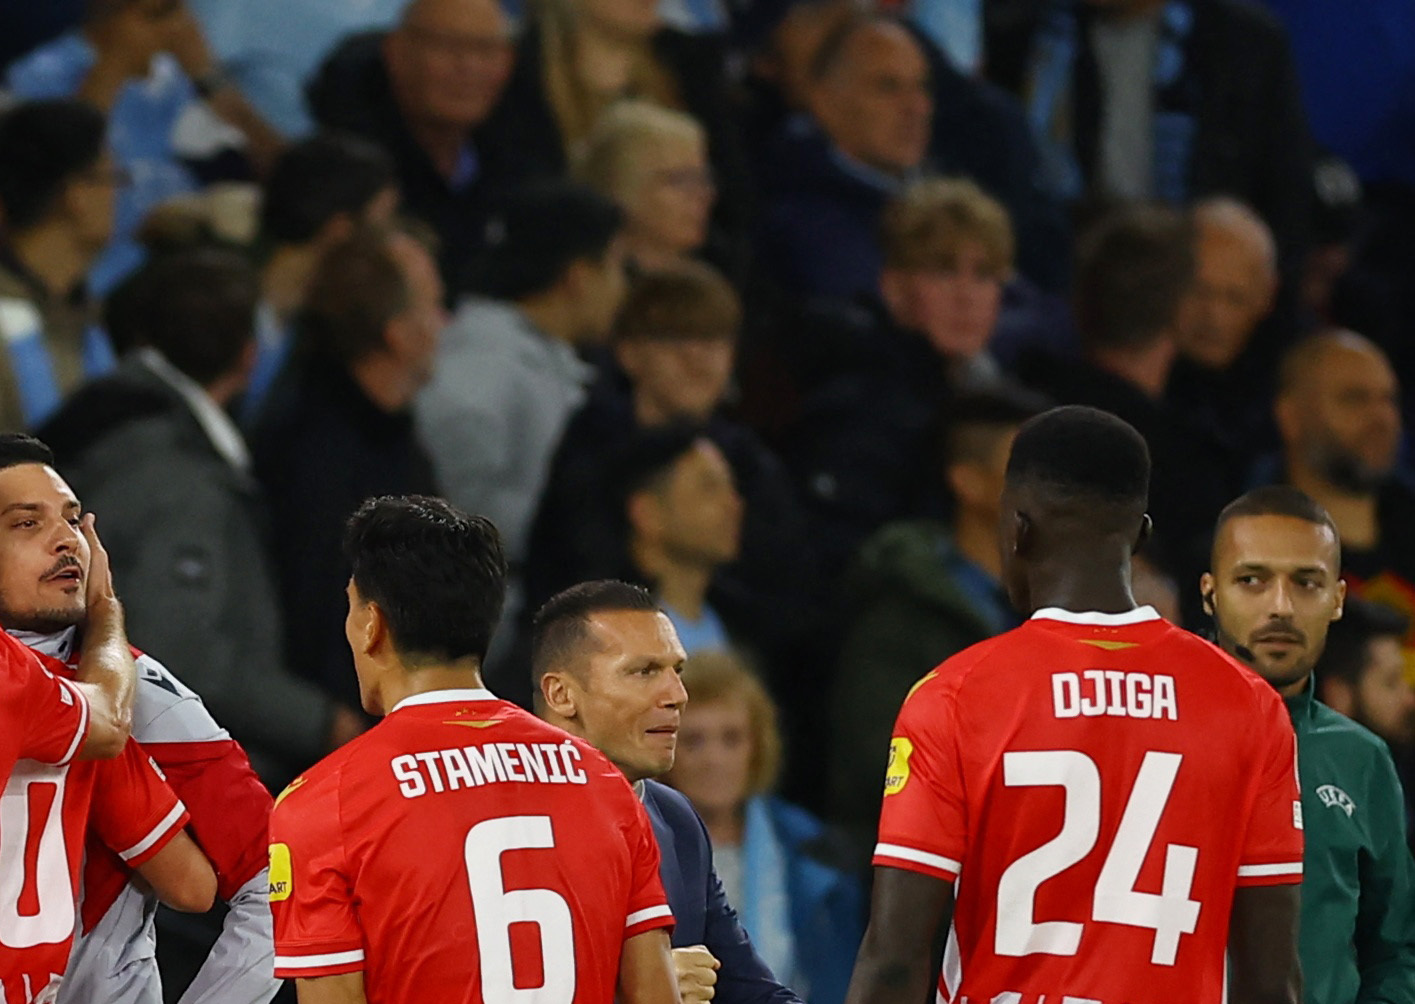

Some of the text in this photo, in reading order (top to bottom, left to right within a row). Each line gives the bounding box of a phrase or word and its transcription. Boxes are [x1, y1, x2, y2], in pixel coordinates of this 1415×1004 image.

[1051, 669, 1178, 720] DJIGA
[390, 739, 588, 799] STAMENIĆ
[994, 750, 1202, 966] 24
